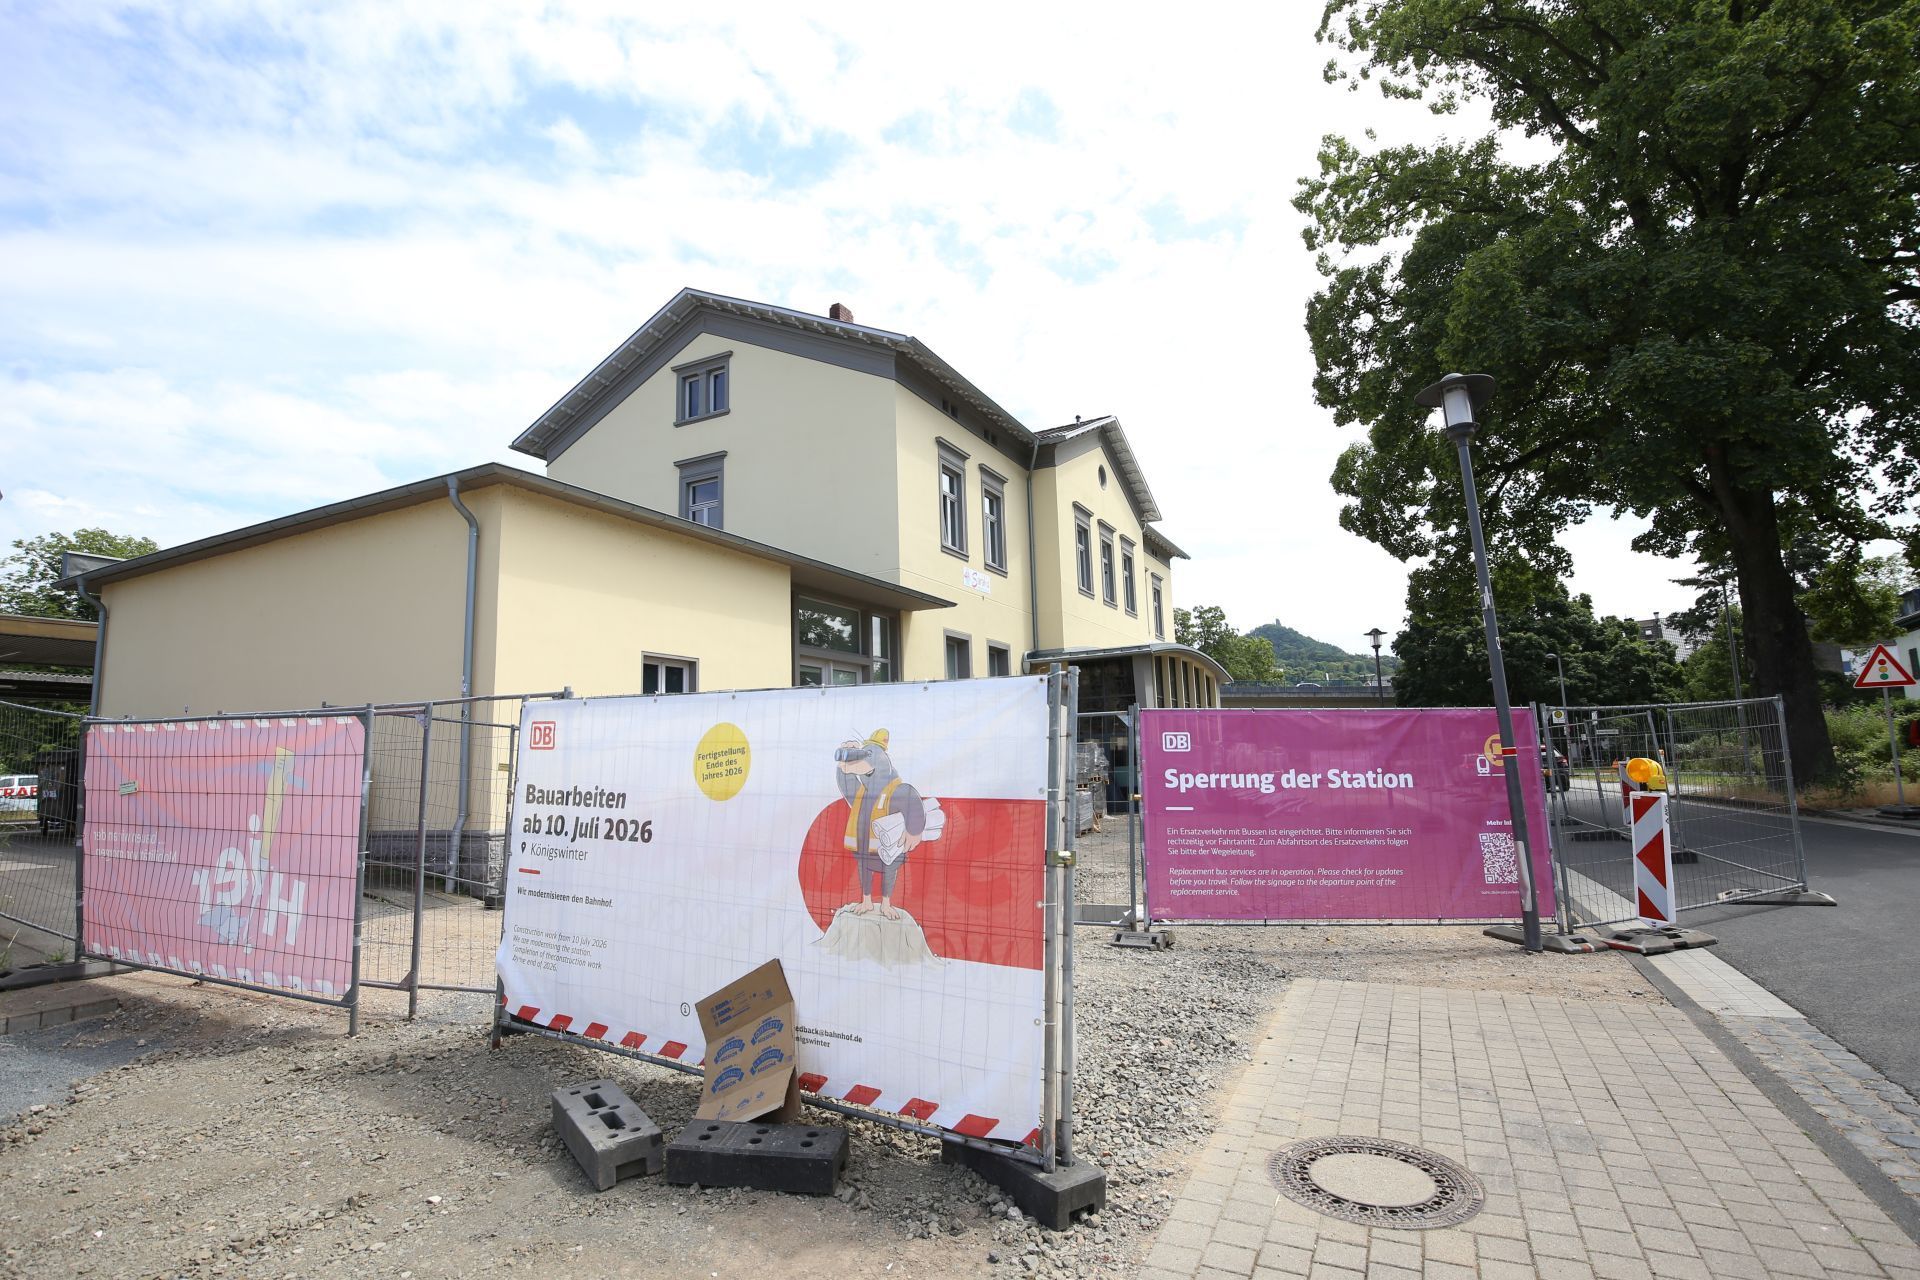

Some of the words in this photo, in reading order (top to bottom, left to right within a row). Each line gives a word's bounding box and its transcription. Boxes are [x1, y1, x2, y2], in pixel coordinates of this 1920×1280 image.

[531, 724, 553, 748] DB
[1165, 734, 1188, 750] DB
[698, 747, 746, 760] Fertigstellung
[706, 760, 724, 770] Ende
[725, 758, 738, 766] des
[702, 771, 724, 782] Jahres
[724, 766, 742, 777] 2026
[1165, 768, 1275, 794] Sperrung
[1281, 768, 1322, 789] der
[1327, 768, 1414, 789] Station
[525, 784, 627, 810] Bauarbeiten
[522, 814, 542, 834] ab
[545, 814, 569, 837] 10.
[570, 816, 599, 842] Juli
[603, 818, 653, 843] 2026
[1279, 828, 1323, 837] eingerichtet.
[1168, 838, 1204, 846] rechtzeitig
[1387, 838, 1408, 846] folgen
[530, 842, 588, 861] Königswinter
[1211, 848, 1256, 857] Wegeleitung.
[1169, 868, 1214, 876] Replacement
[1364, 868, 1374, 876] for
[1376, 868, 1404, 876] updates
[1170, 878, 1192, 886] before
[1267, 878, 1295, 887] signage
[1319, 878, 1355, 886] departure
[1356, 878, 1374, 886] point
[1376, 878, 1384, 886] of
[517, 886, 526, 894] Wir
[528, 889, 570, 901] modernisieren
[572, 895, 583, 903] den
[585, 896, 613, 908] Bahnhof.
[1170, 888, 1213, 896] replacement
[514, 924, 543, 936] Construction
[545, 932, 557, 940] work
[558, 932, 571, 942] from
[572, 935, 579, 944] 10
[579, 936, 591, 946] July
[592, 938, 607, 949] 2026
[530, 939, 560, 952] modernising
[562, 944, 570, 953] the
[513, 945, 538, 956] Completion
[588, 961, 602, 970] work
[527, 959, 536, 967] end
[537, 961, 543, 970] of
[794, 1025, 862, 1043] edback@bahnhof.de
[796, 1036, 830, 1048] nigswinter
